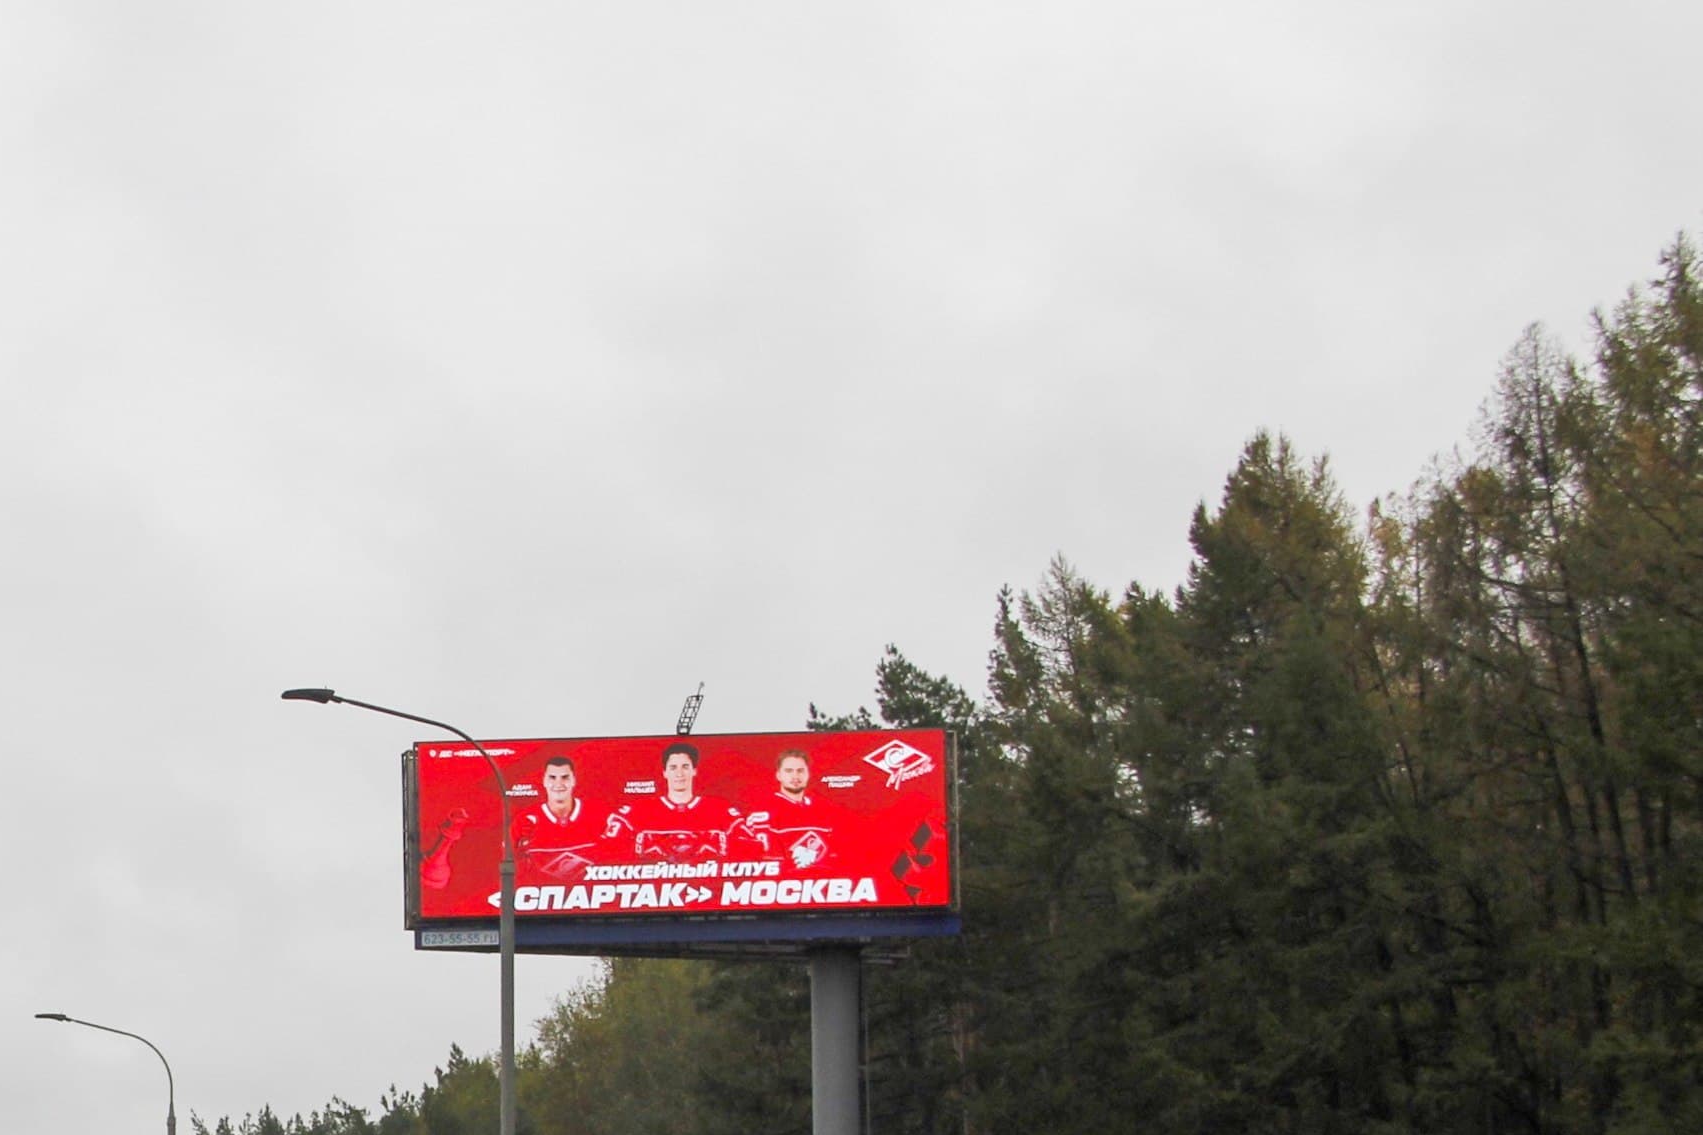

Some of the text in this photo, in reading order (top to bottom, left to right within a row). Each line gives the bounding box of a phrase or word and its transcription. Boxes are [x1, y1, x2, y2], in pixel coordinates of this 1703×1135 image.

[584, 861, 780, 881] ХОККЕЙНЫЙ КЛУБ
[720, 877, 878, 906] МОСКВА
